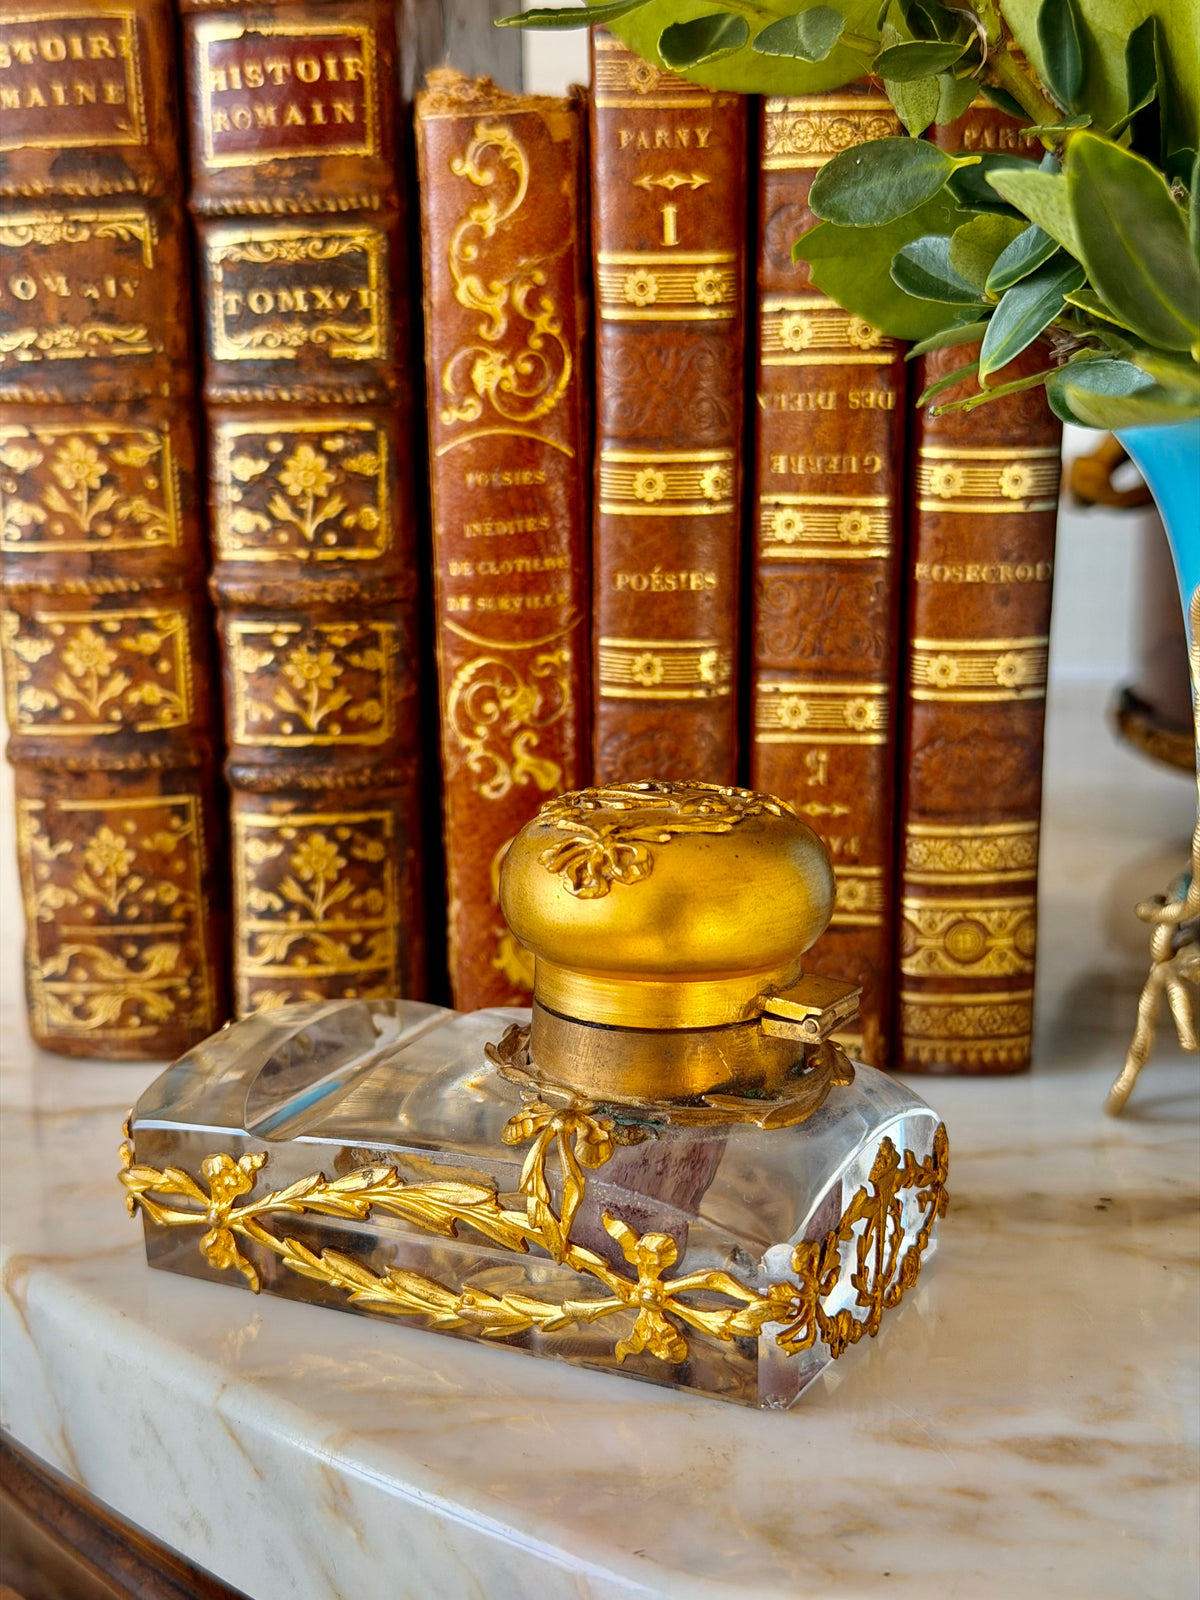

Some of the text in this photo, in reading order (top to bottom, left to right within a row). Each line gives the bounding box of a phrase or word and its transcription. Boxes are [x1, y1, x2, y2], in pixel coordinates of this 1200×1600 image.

[211, 98, 368, 133] ROMAIN
[618, 127, 712, 149] PARNY
[847, 390, 896, 410] DES
[769, 452, 883, 474] GUERRE
[612, 564, 718, 592] POÉSIES
